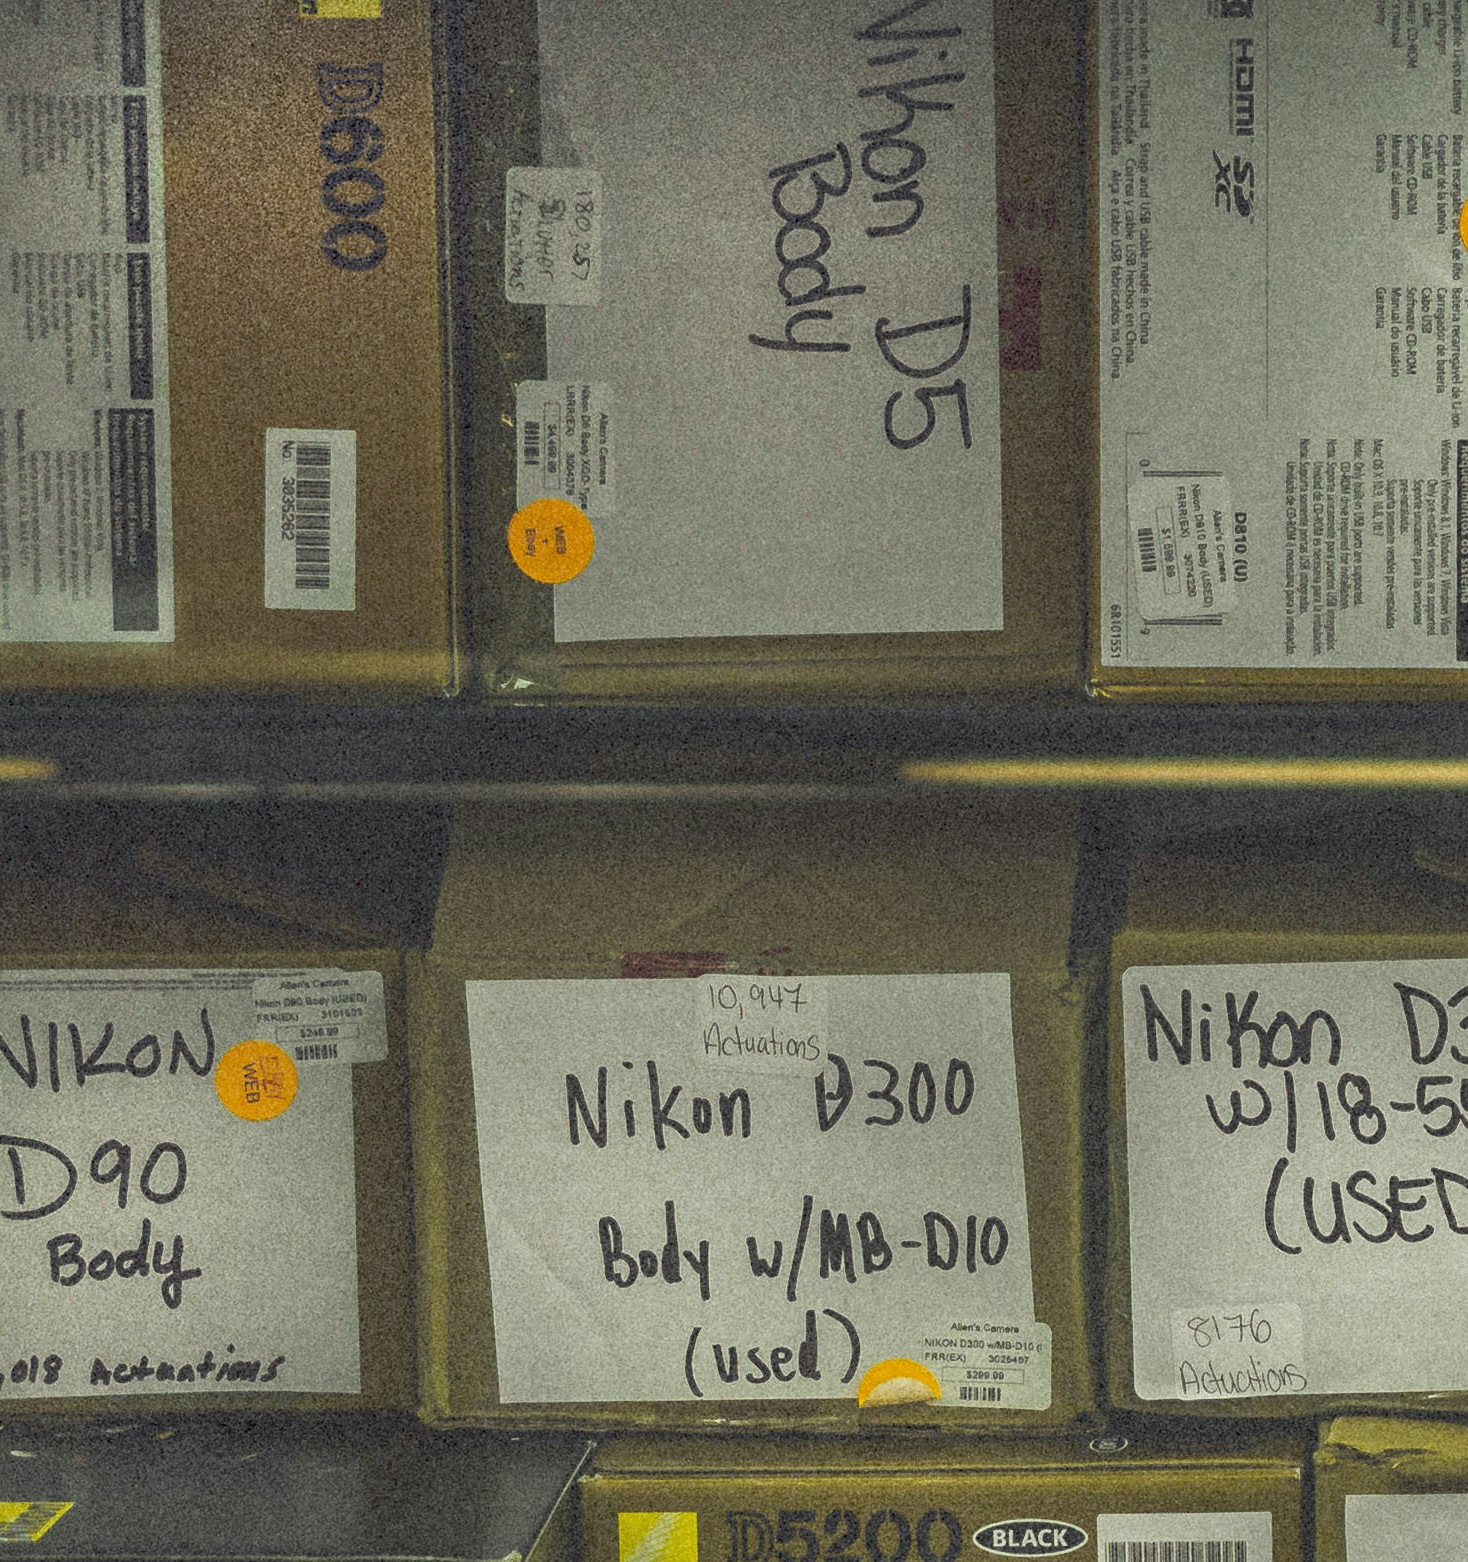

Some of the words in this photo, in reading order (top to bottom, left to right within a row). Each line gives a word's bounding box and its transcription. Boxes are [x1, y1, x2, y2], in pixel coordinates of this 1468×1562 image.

[855, 0, 964, 238] Nikon
[317, 62, 387, 271] D600
[748, 141, 866, 353] Body
[873, 284, 972, 449] D5
[702, 1023, 821, 1062] Actuations
[707, 982, 805, 1019] 10,947
[1142, 985, 1341, 1067] Nikon
[565, 1060, 752, 1149] Nikon
[814, 1056, 974, 1132] D300
[47, 1217, 202, 1308] Body
[598, 1198, 712, 1302] Body
[745, 1194, 1007, 1302] w/MB-D10
[684, 1307, 861, 1398] (used)
[1186, 1309, 1273, 1348] 8176
[992, 1528, 1069, 1549] BLACK
